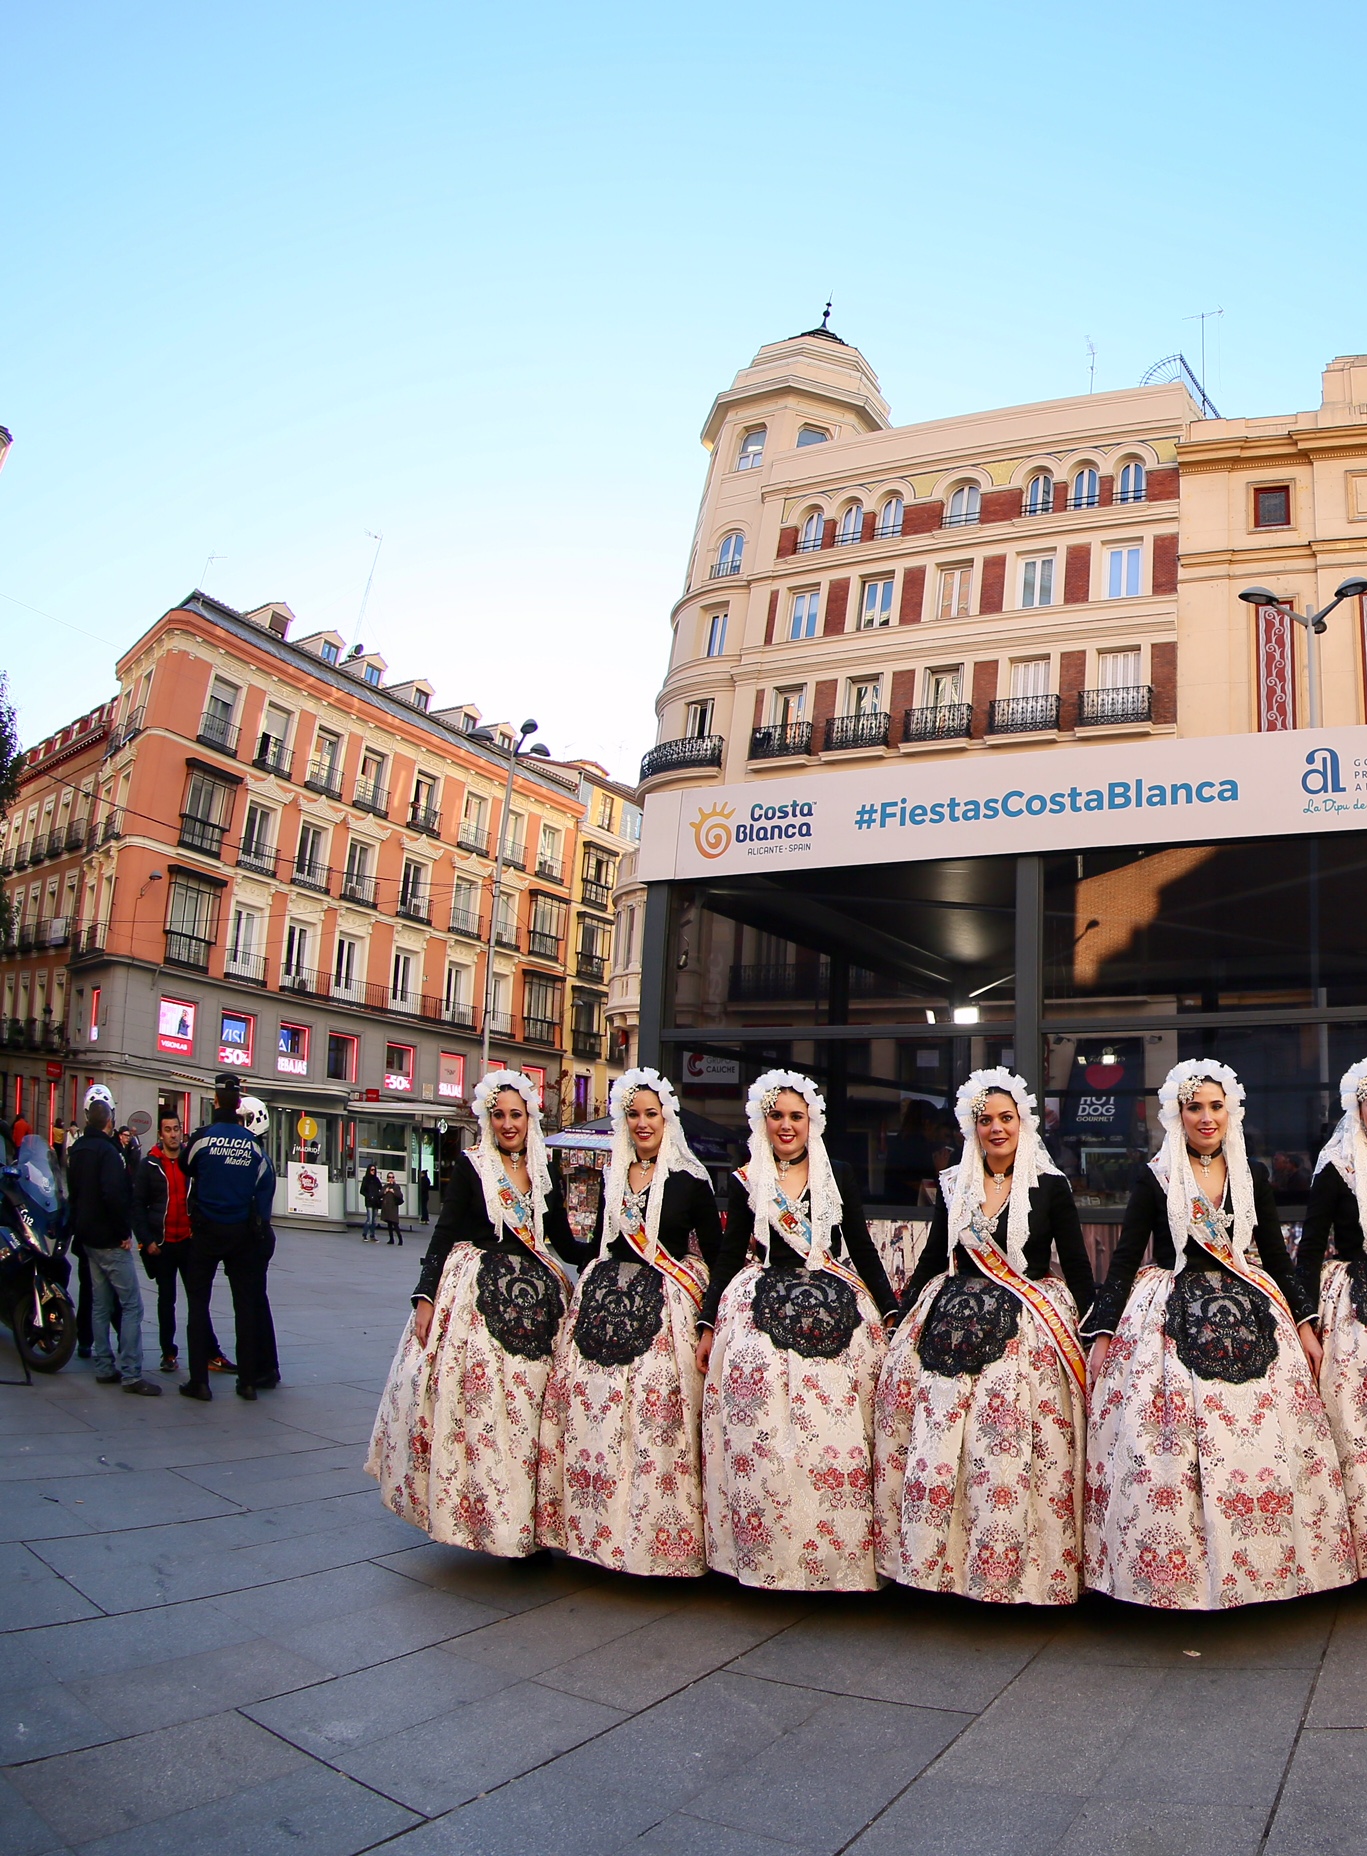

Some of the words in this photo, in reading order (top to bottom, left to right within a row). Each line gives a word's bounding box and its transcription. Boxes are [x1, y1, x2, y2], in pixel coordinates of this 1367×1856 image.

[750, 799, 813, 822] Costa
[854, 778, 1240, 830] #FiestasCostaBlanca
[1303, 798, 1320, 813] La
[1322, 798, 1349, 815] Dipu
[1353, 798, 1367, 809] de
[735, 821, 812, 843] Blanca
[219, 1047, 250, 1066] -50%
[706, 1066, 735, 1074] CALICHE
[385, 1074, 411, 1091] -50%
[1077, 1105, 1115, 1116] DOG
[208, 1136, 252, 1149] POLICÍA
[209, 1147, 252, 1159] MUNICIPAL
[224, 1156, 251, 1167] Madrid
